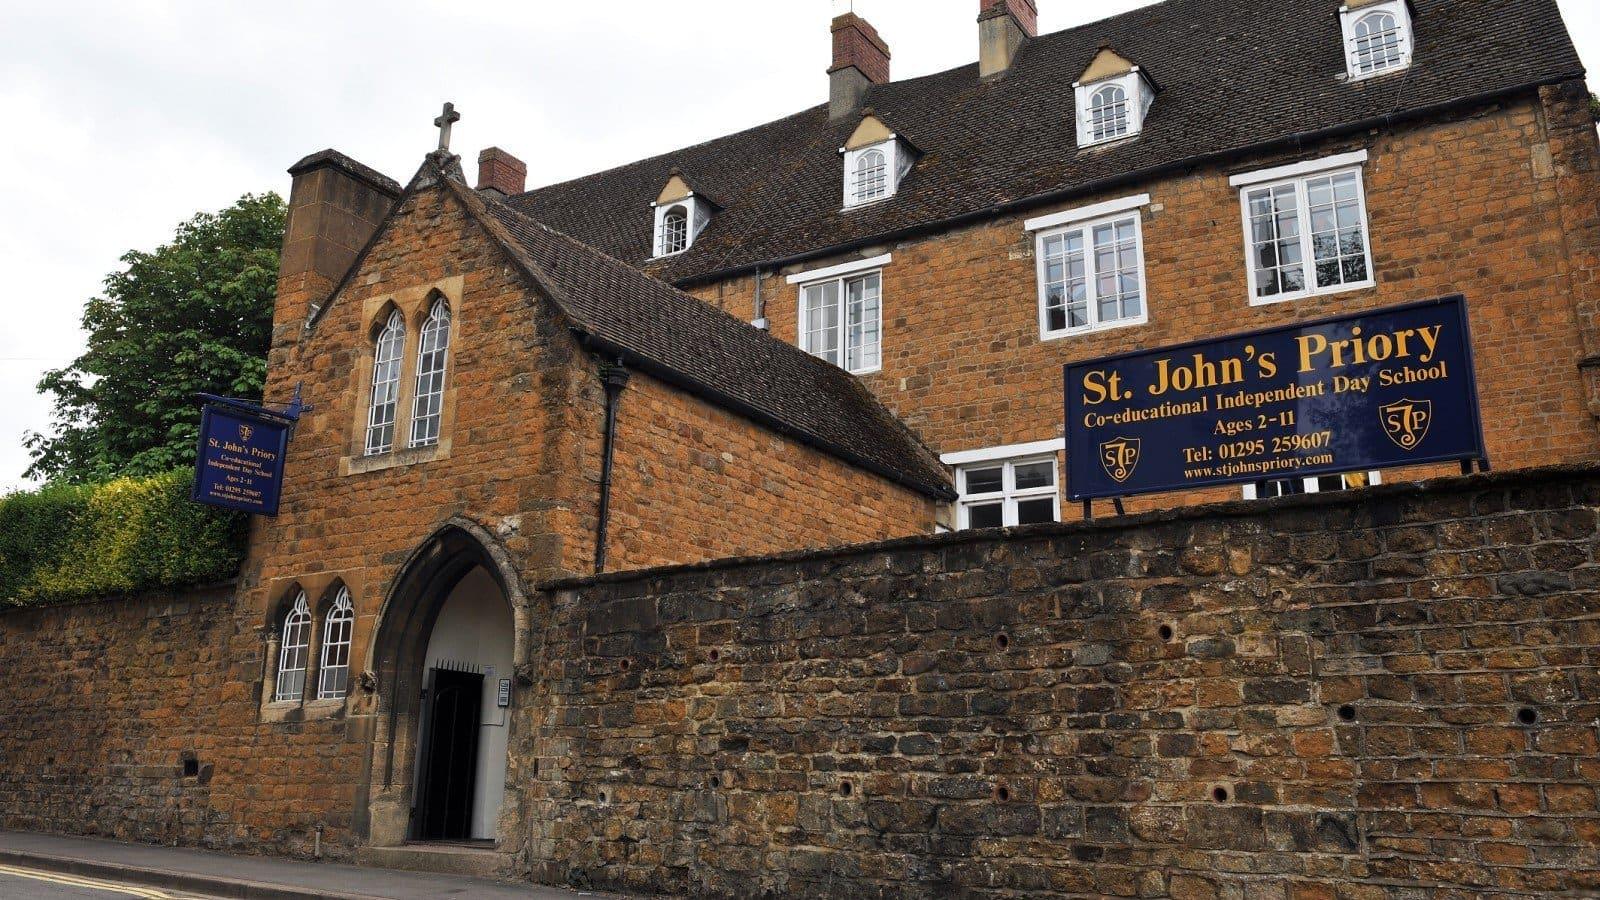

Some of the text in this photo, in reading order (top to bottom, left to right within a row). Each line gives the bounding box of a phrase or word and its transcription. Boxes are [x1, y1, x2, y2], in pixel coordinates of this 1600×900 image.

[1083, 325, 1442, 405] St. John's Priory
[1084, 361, 1448, 428] Co-educational Independent Day School
[1214, 417, 1253, 436] Ages
[209, 438, 276, 460] St. John's Priory
[1183, 431, 1332, 464] Tel: 01295 259607
[208, 459, 273, 478] Independent Day School
[1184, 453, 1333, 479] www.stjohnspriory.com
[213, 483, 224, 491] Tel:
[226, 475, 238, 483] Ages
